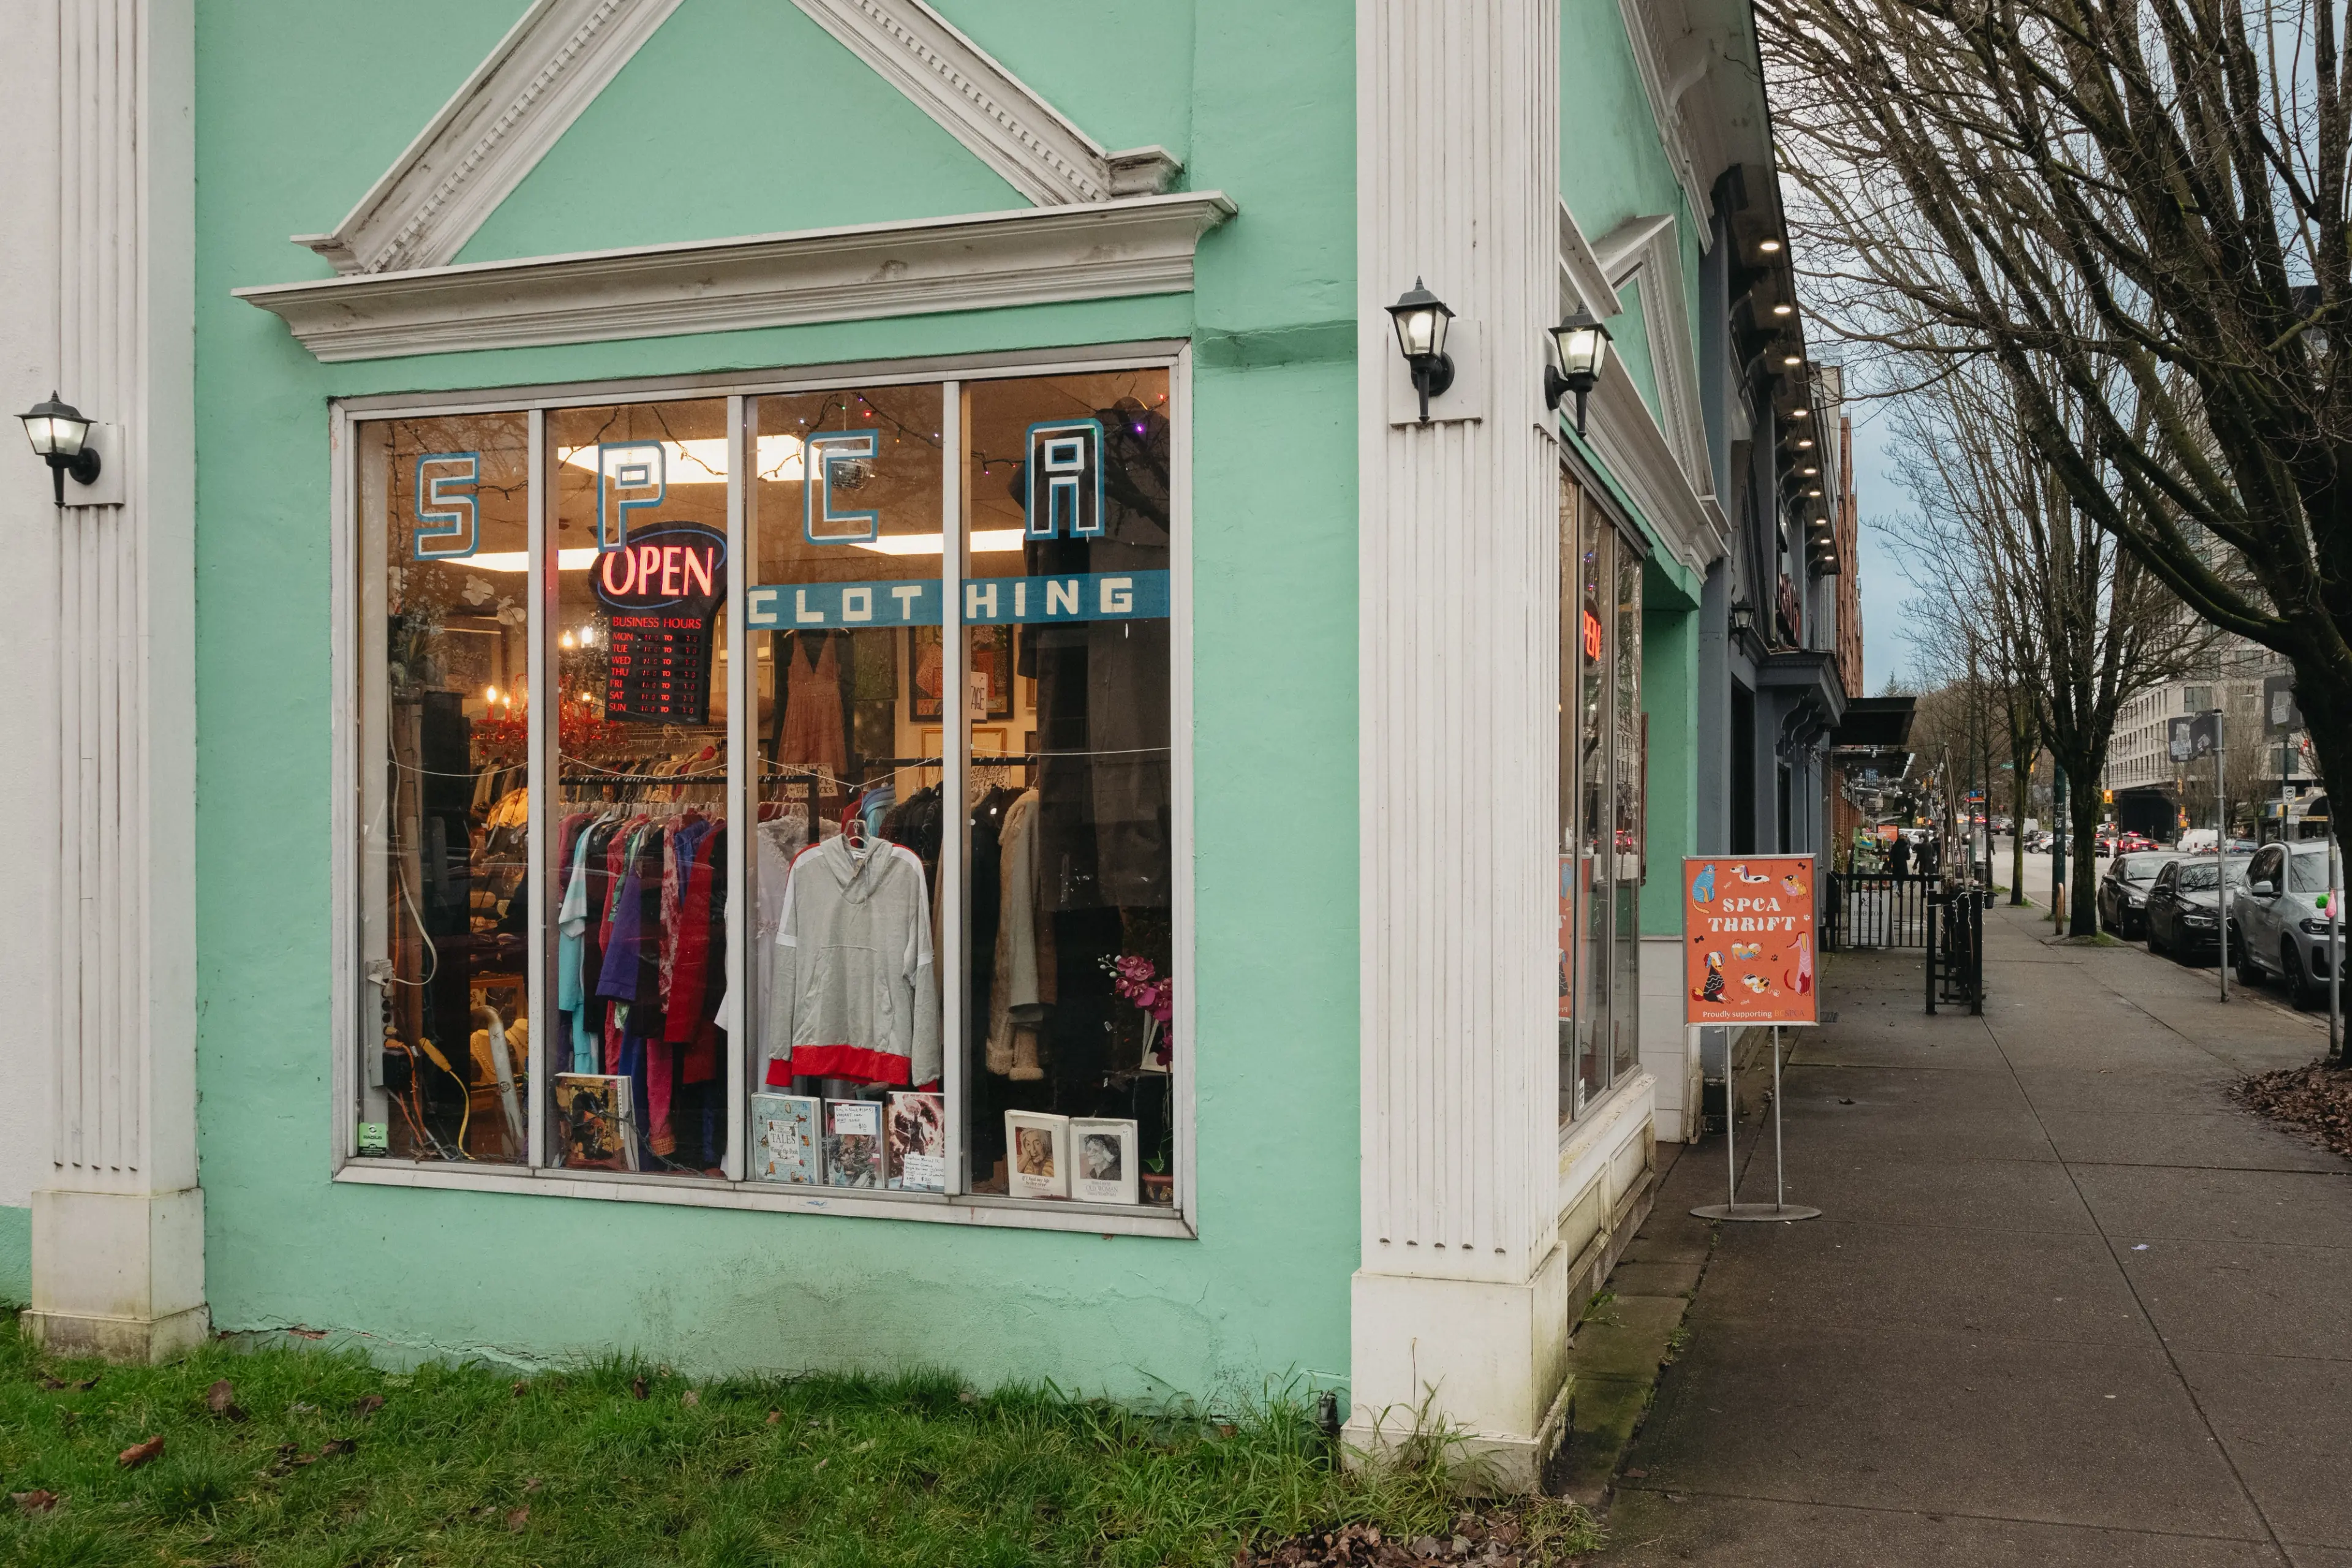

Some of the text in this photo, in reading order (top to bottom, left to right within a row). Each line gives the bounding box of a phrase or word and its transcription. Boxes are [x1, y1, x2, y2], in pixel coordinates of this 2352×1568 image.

[602, 545, 714, 596] OPEN
[748, 577, 1133, 624] CLOTHING
[613, 617, 701, 629] BUSINESS HOURS
[611, 656, 631, 665] WED
[611, 668, 629, 676] THU
[609, 679, 623, 688] FRI
[609, 691, 624, 700] SAT
[1722, 897, 1781, 912] SPCA
[1708, 916, 1796, 932] THRIFT
[771, 1133, 796, 1144] TALES
